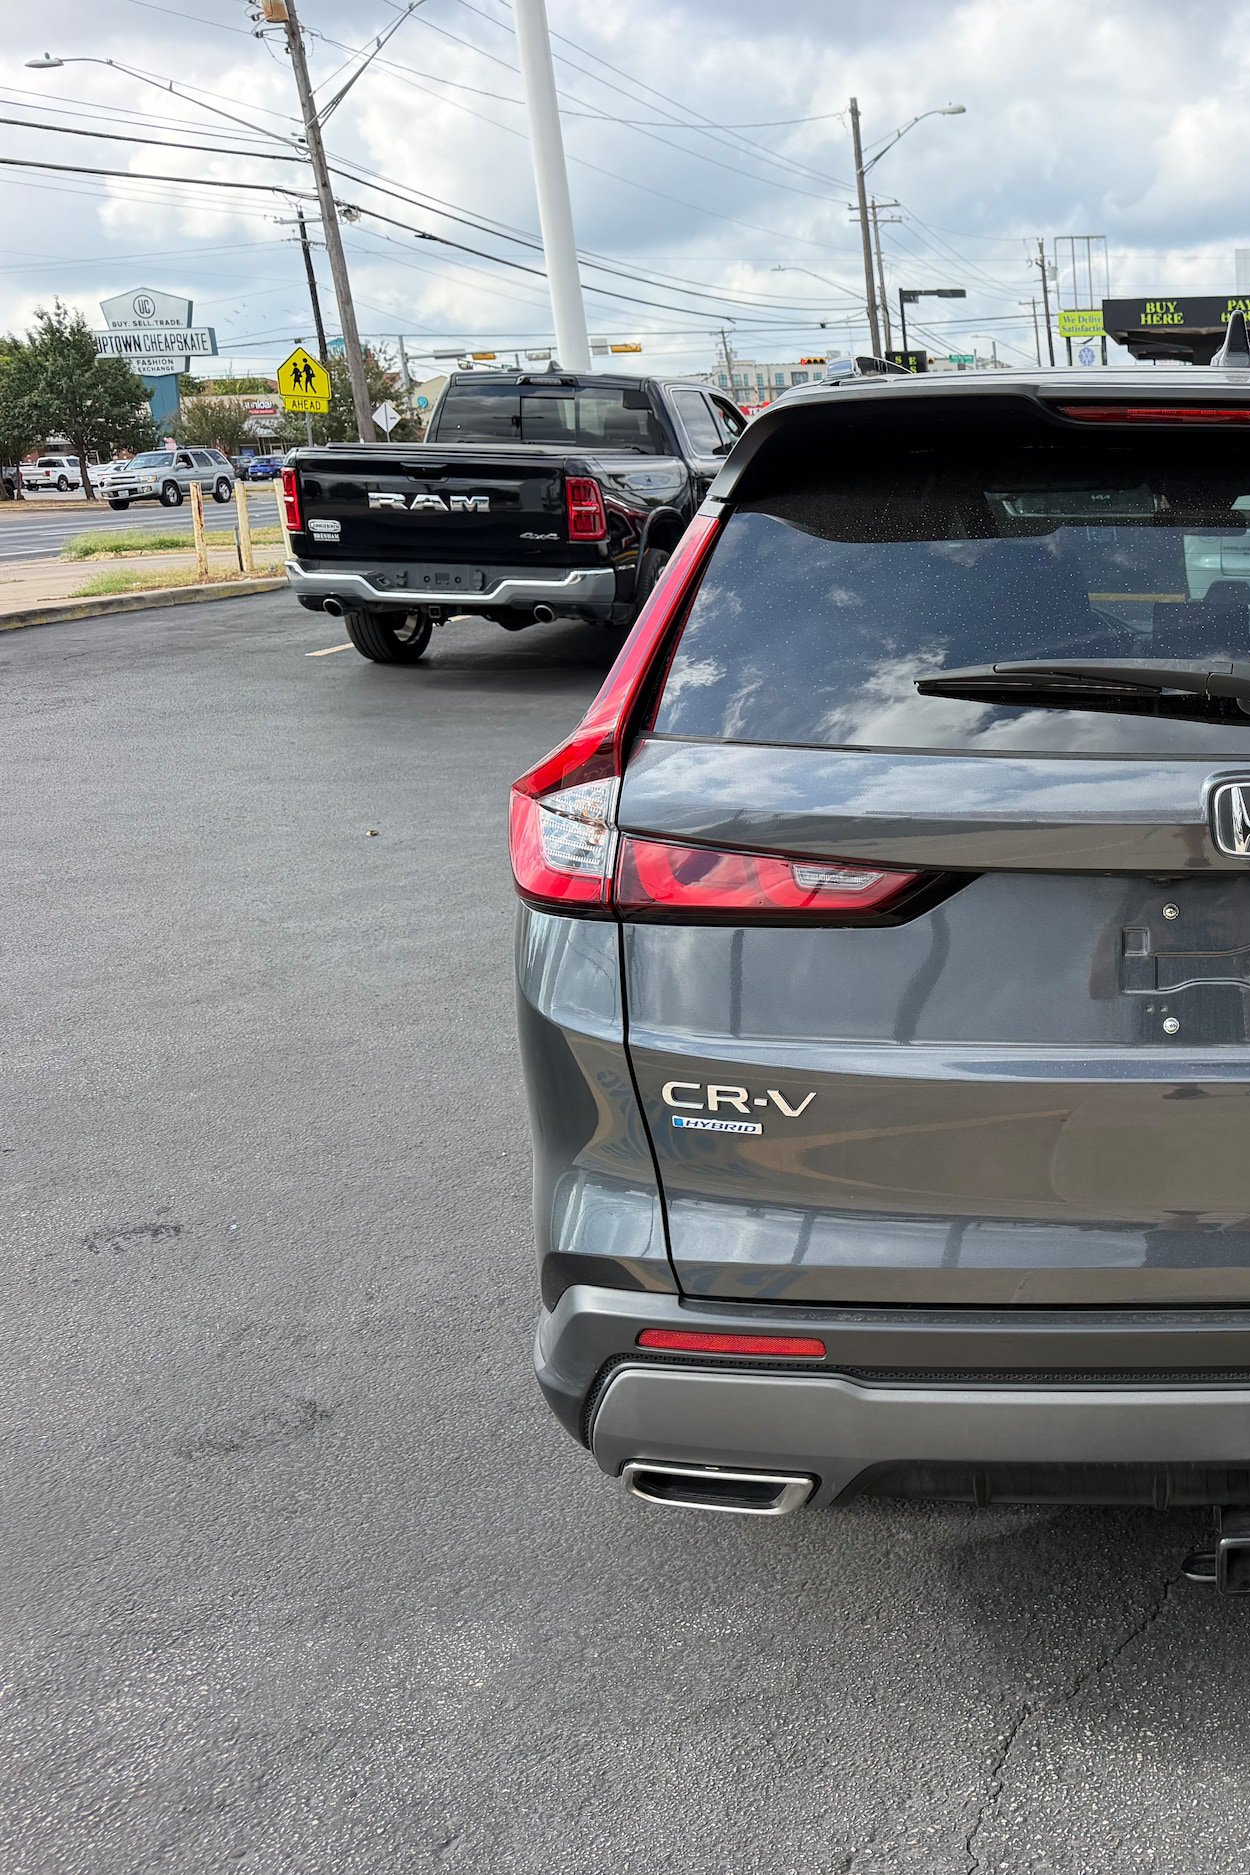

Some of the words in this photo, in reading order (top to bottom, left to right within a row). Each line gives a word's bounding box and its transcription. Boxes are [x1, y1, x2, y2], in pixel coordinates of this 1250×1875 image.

[138, 299, 151, 315] UC
[1145, 301, 1178, 313] BUY
[1140, 312, 1185, 325] HERE
[142, 333, 209, 352] CHEAPSKATE
[136, 358, 174, 366] FASHION
[291, 400, 321, 411] AHEAD
[367, 492, 491, 513] RAM
[661, 1081, 818, 1117] CR-V
[685, 1119, 757, 1133] HYBRID
